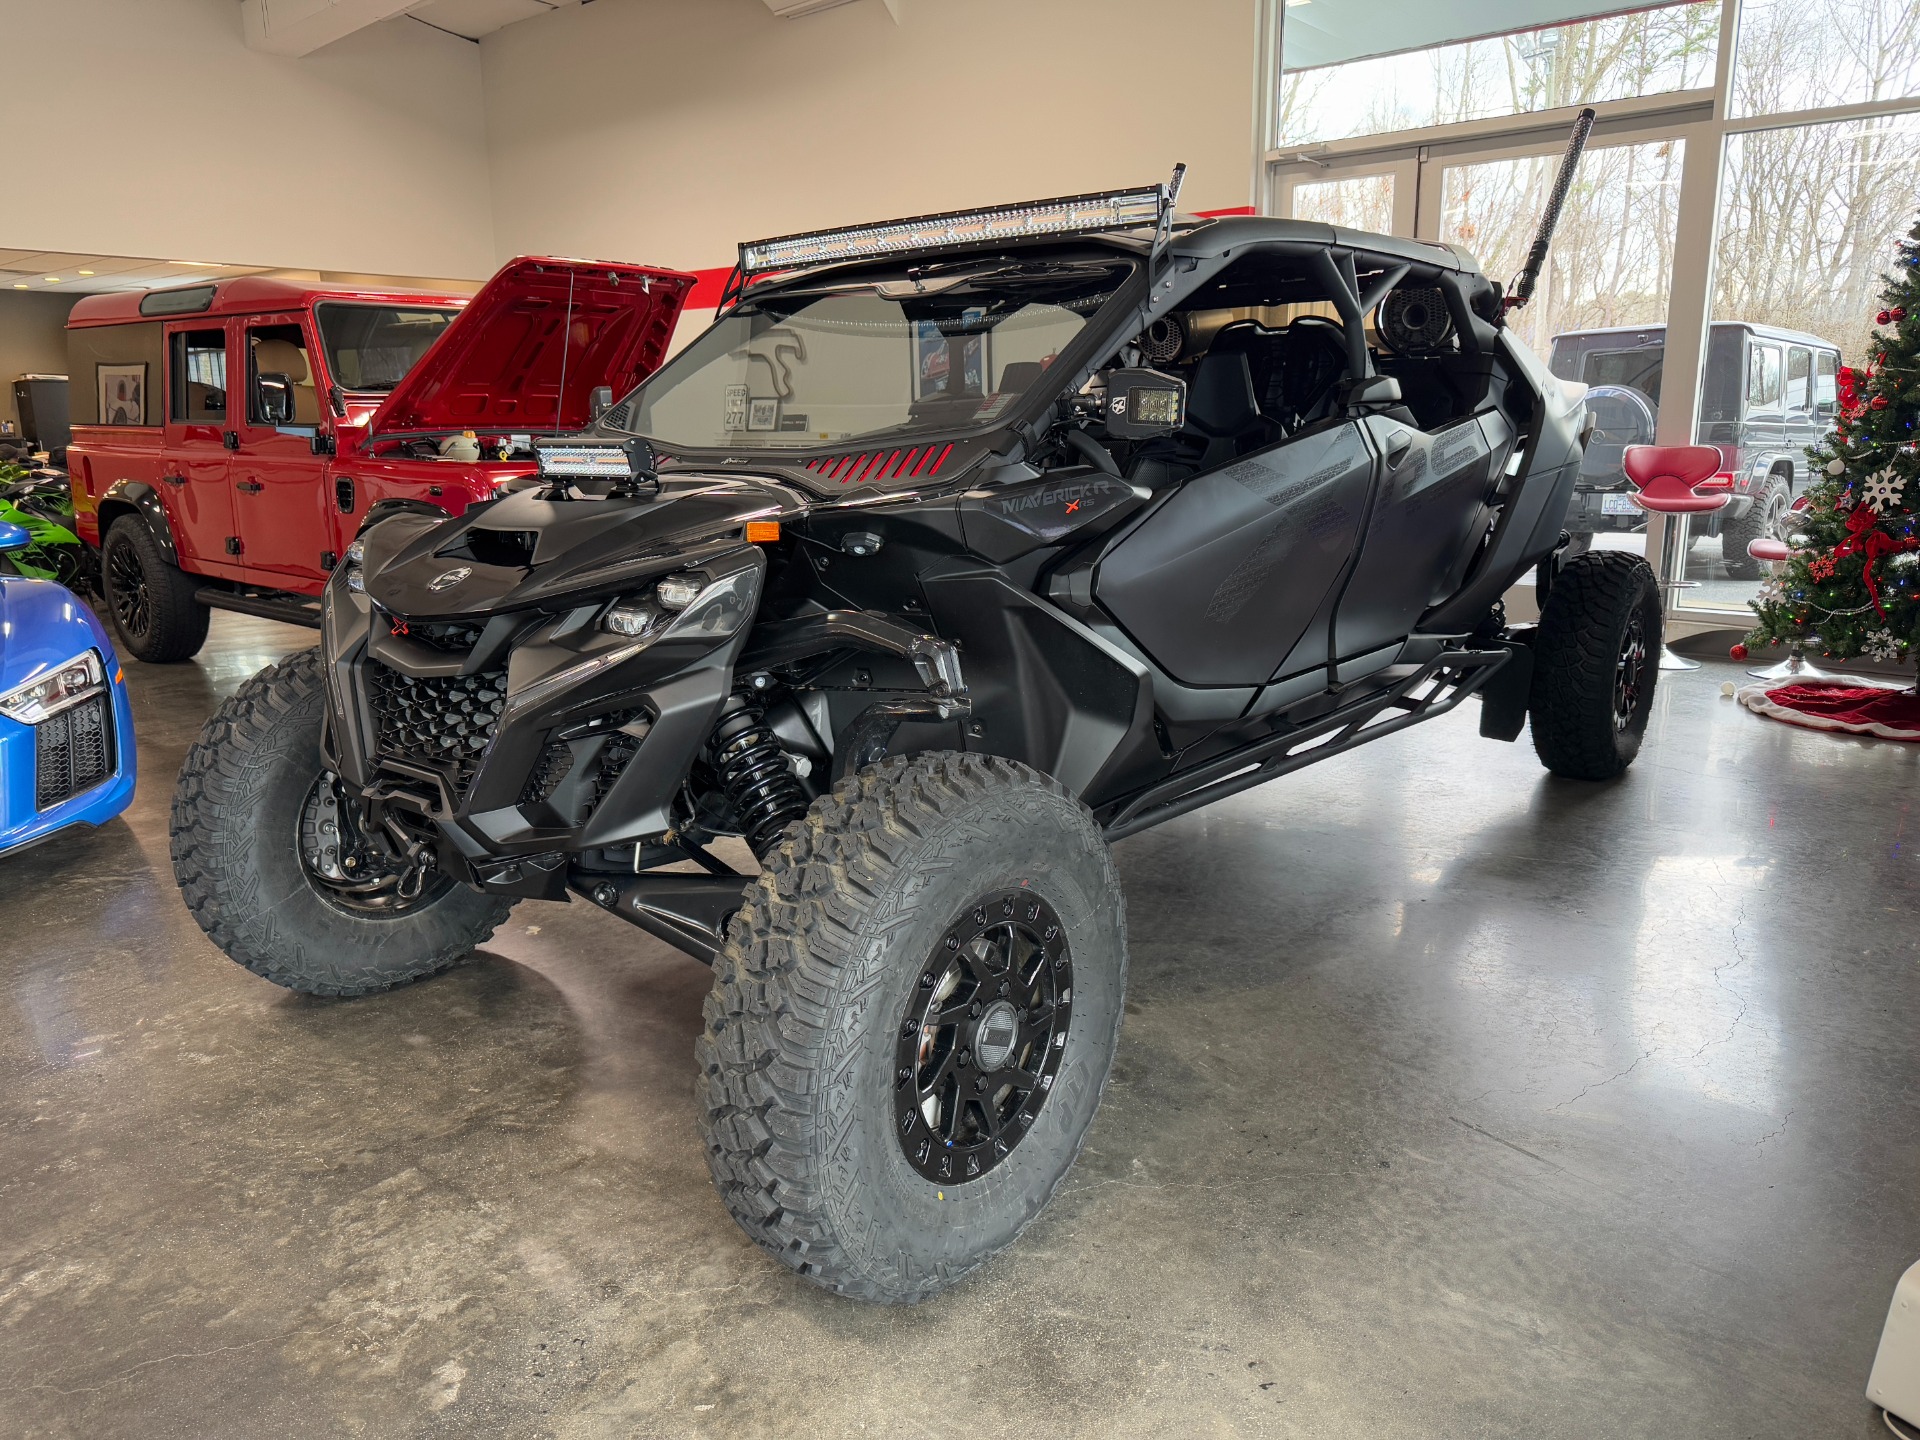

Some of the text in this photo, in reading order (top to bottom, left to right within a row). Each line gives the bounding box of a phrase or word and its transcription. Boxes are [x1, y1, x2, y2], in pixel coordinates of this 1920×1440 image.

[727, 388, 746, 397] SPEED
[726, 411, 744, 424] 277
[1002, 480, 1111, 515] MAVERICK R
[1065, 498, 1095, 514] X RS
